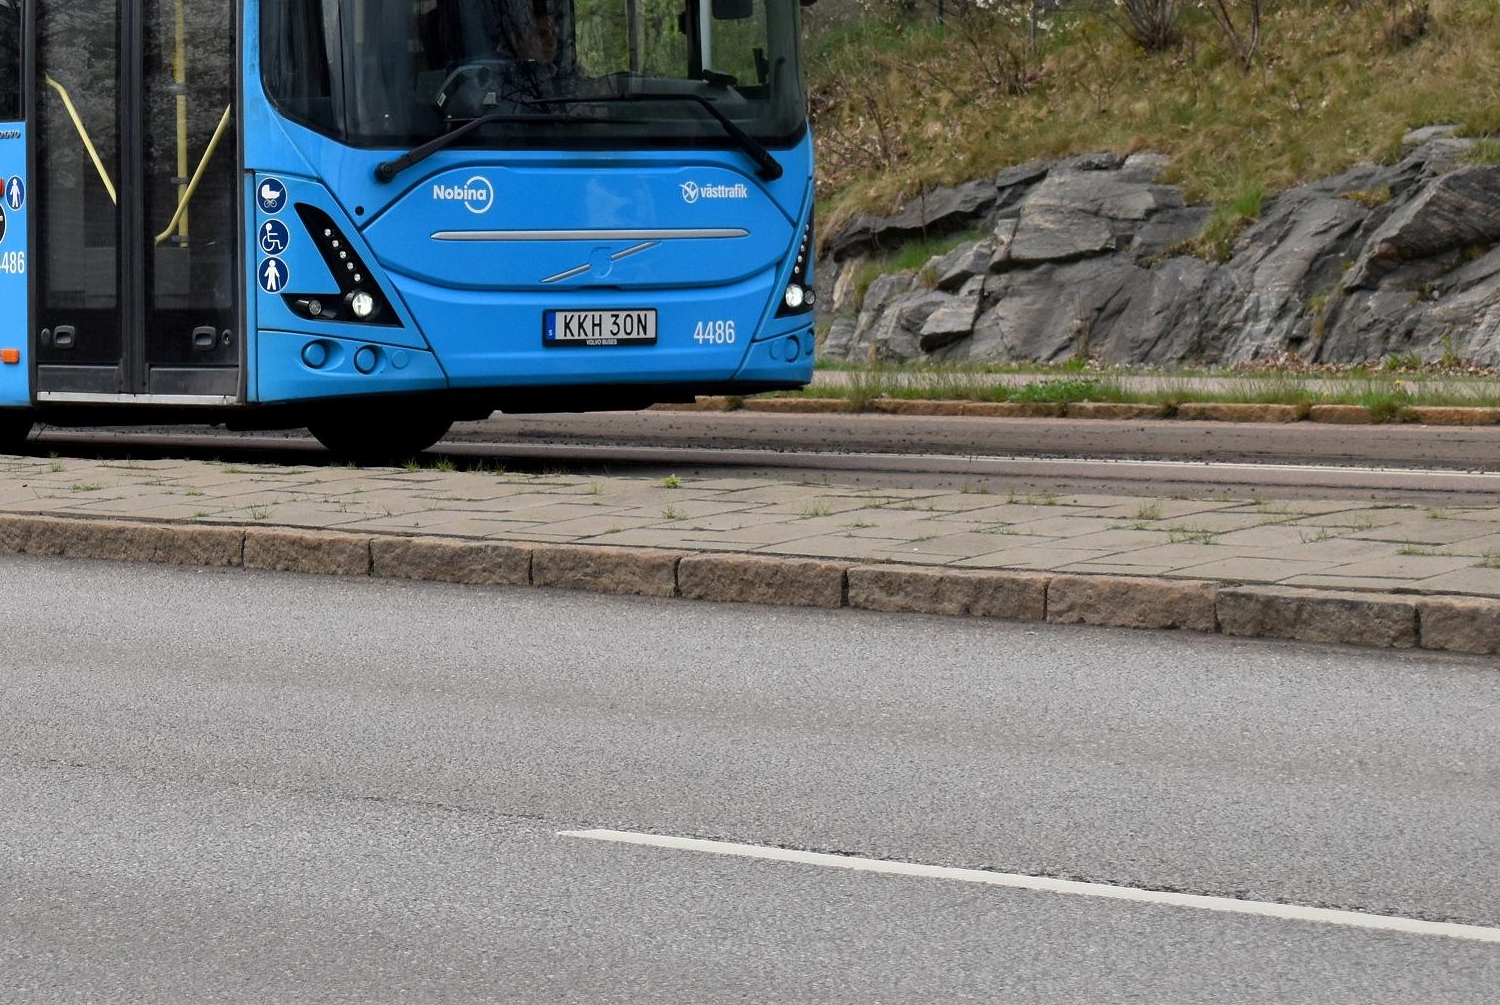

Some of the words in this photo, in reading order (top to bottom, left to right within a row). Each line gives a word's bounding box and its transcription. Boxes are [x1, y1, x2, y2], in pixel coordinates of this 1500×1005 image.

[432, 184, 487, 201] Nobina
[700, 183, 748, 199] västtrafik
[563, 313, 602, 338] KKH
[609, 313, 648, 337] 30N
[693, 320, 735, 344] 4486
